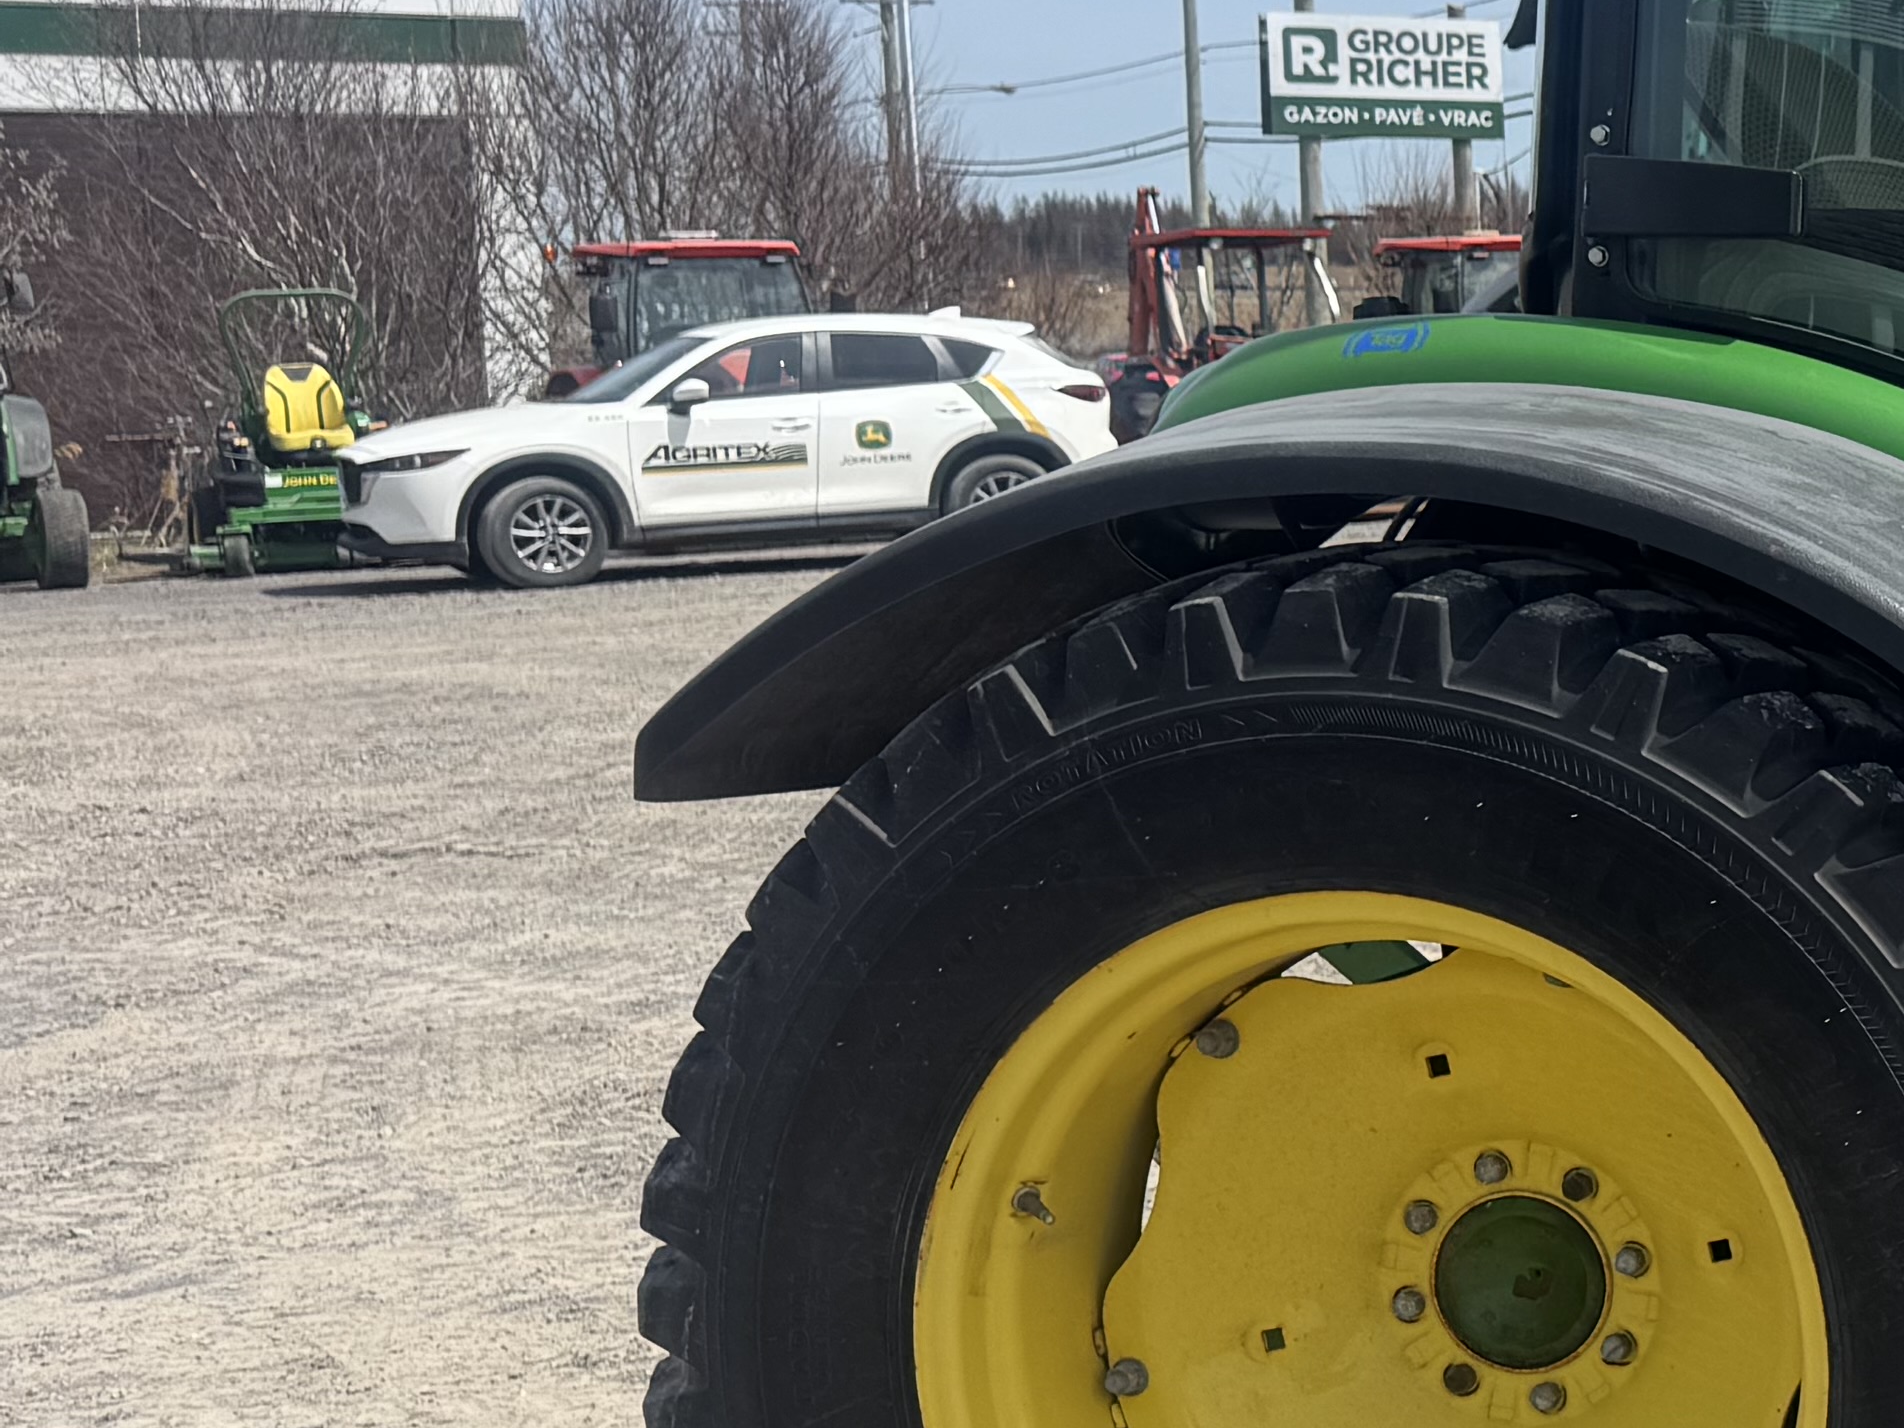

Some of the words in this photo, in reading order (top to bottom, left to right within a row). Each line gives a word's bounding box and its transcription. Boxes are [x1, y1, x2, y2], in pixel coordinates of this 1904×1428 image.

[1347, 29, 1487, 58] GROUPE
[1349, 57, 1490, 89] RICHER
[1284, 105, 1359, 124] GAZON
[1375, 104, 1425, 126] PAVÉ
[1439, 109, 1494, 128] VRAC
[643, 443, 773, 464] AGRITEX
[1011, 718, 1204, 813] ROTATION
